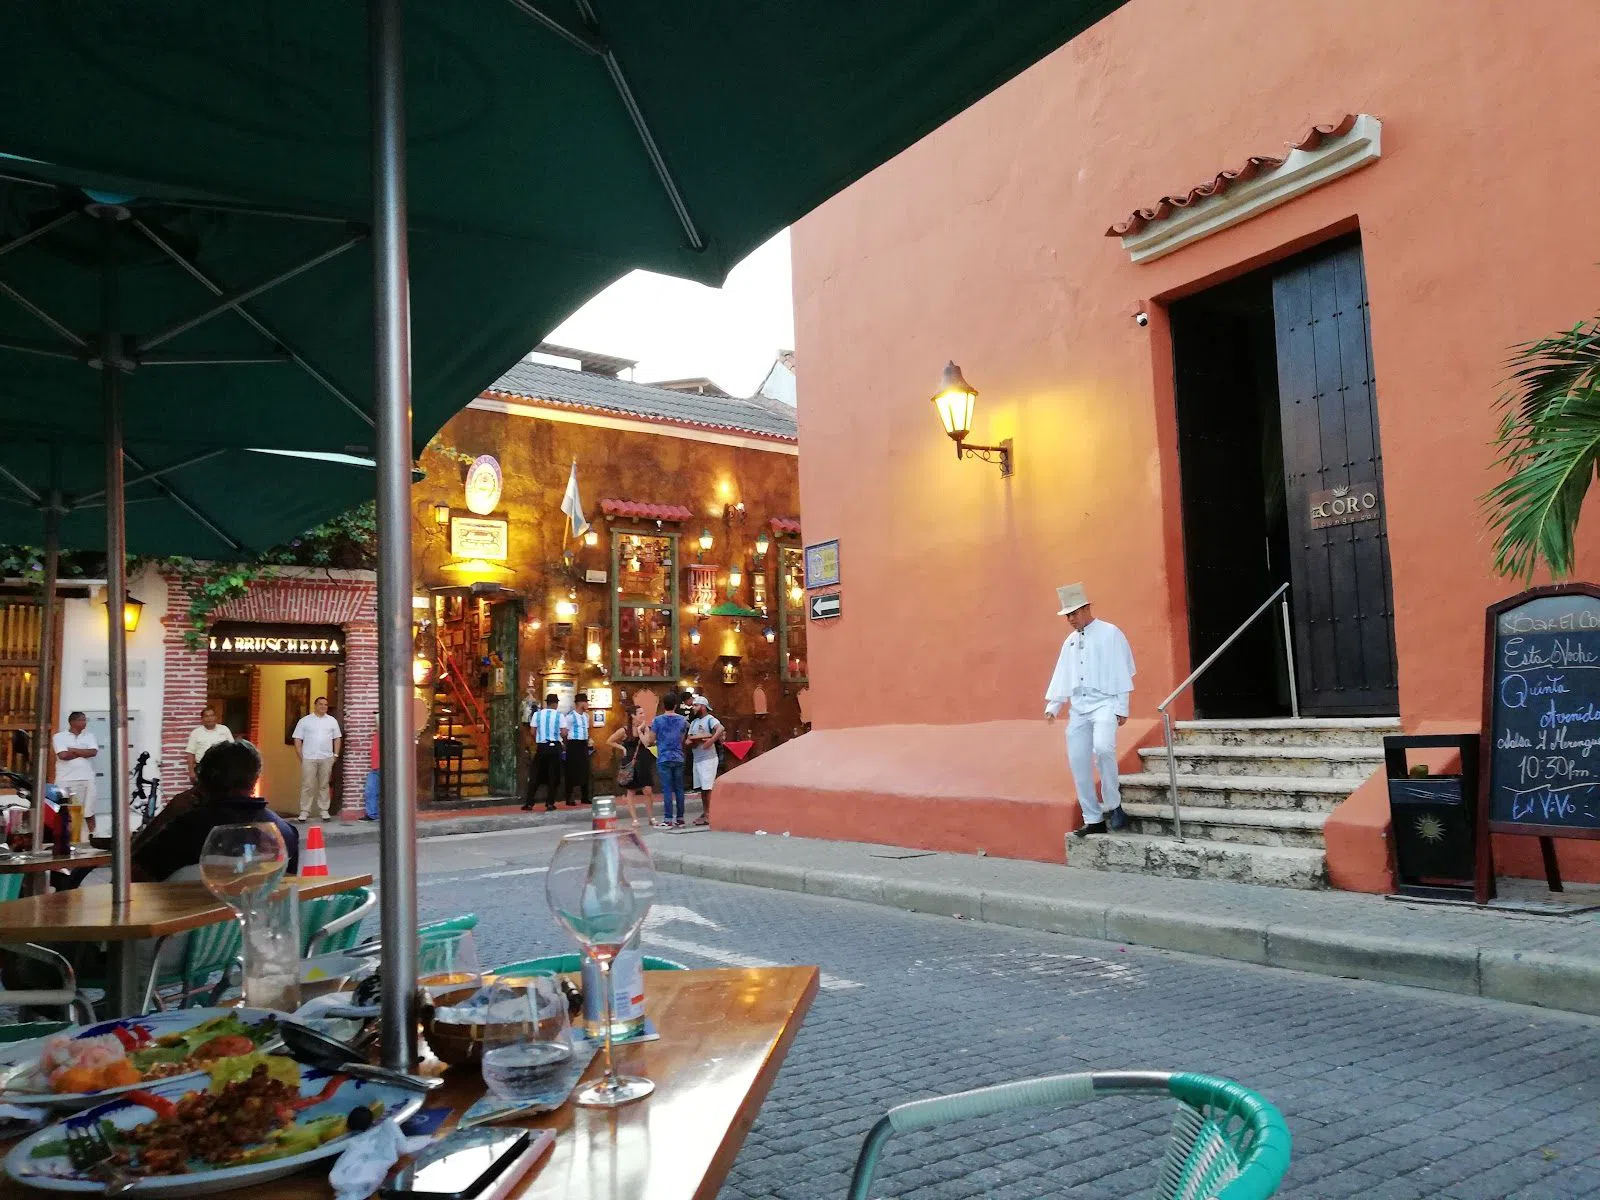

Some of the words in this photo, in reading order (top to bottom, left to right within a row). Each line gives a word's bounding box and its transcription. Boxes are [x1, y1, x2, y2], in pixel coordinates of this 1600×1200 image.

[1320, 492, 1377, 517] CORO
[1579, 610, 1600, 629] Co
[234, 637, 340, 654] BRUSCHETTA
[1504, 637, 1550, 668] Esta
[1550, 638, 1598, 666] Noche
[1500, 673, 1571, 708] Quinta
[1550, 725, 1600, 758] Merengu
